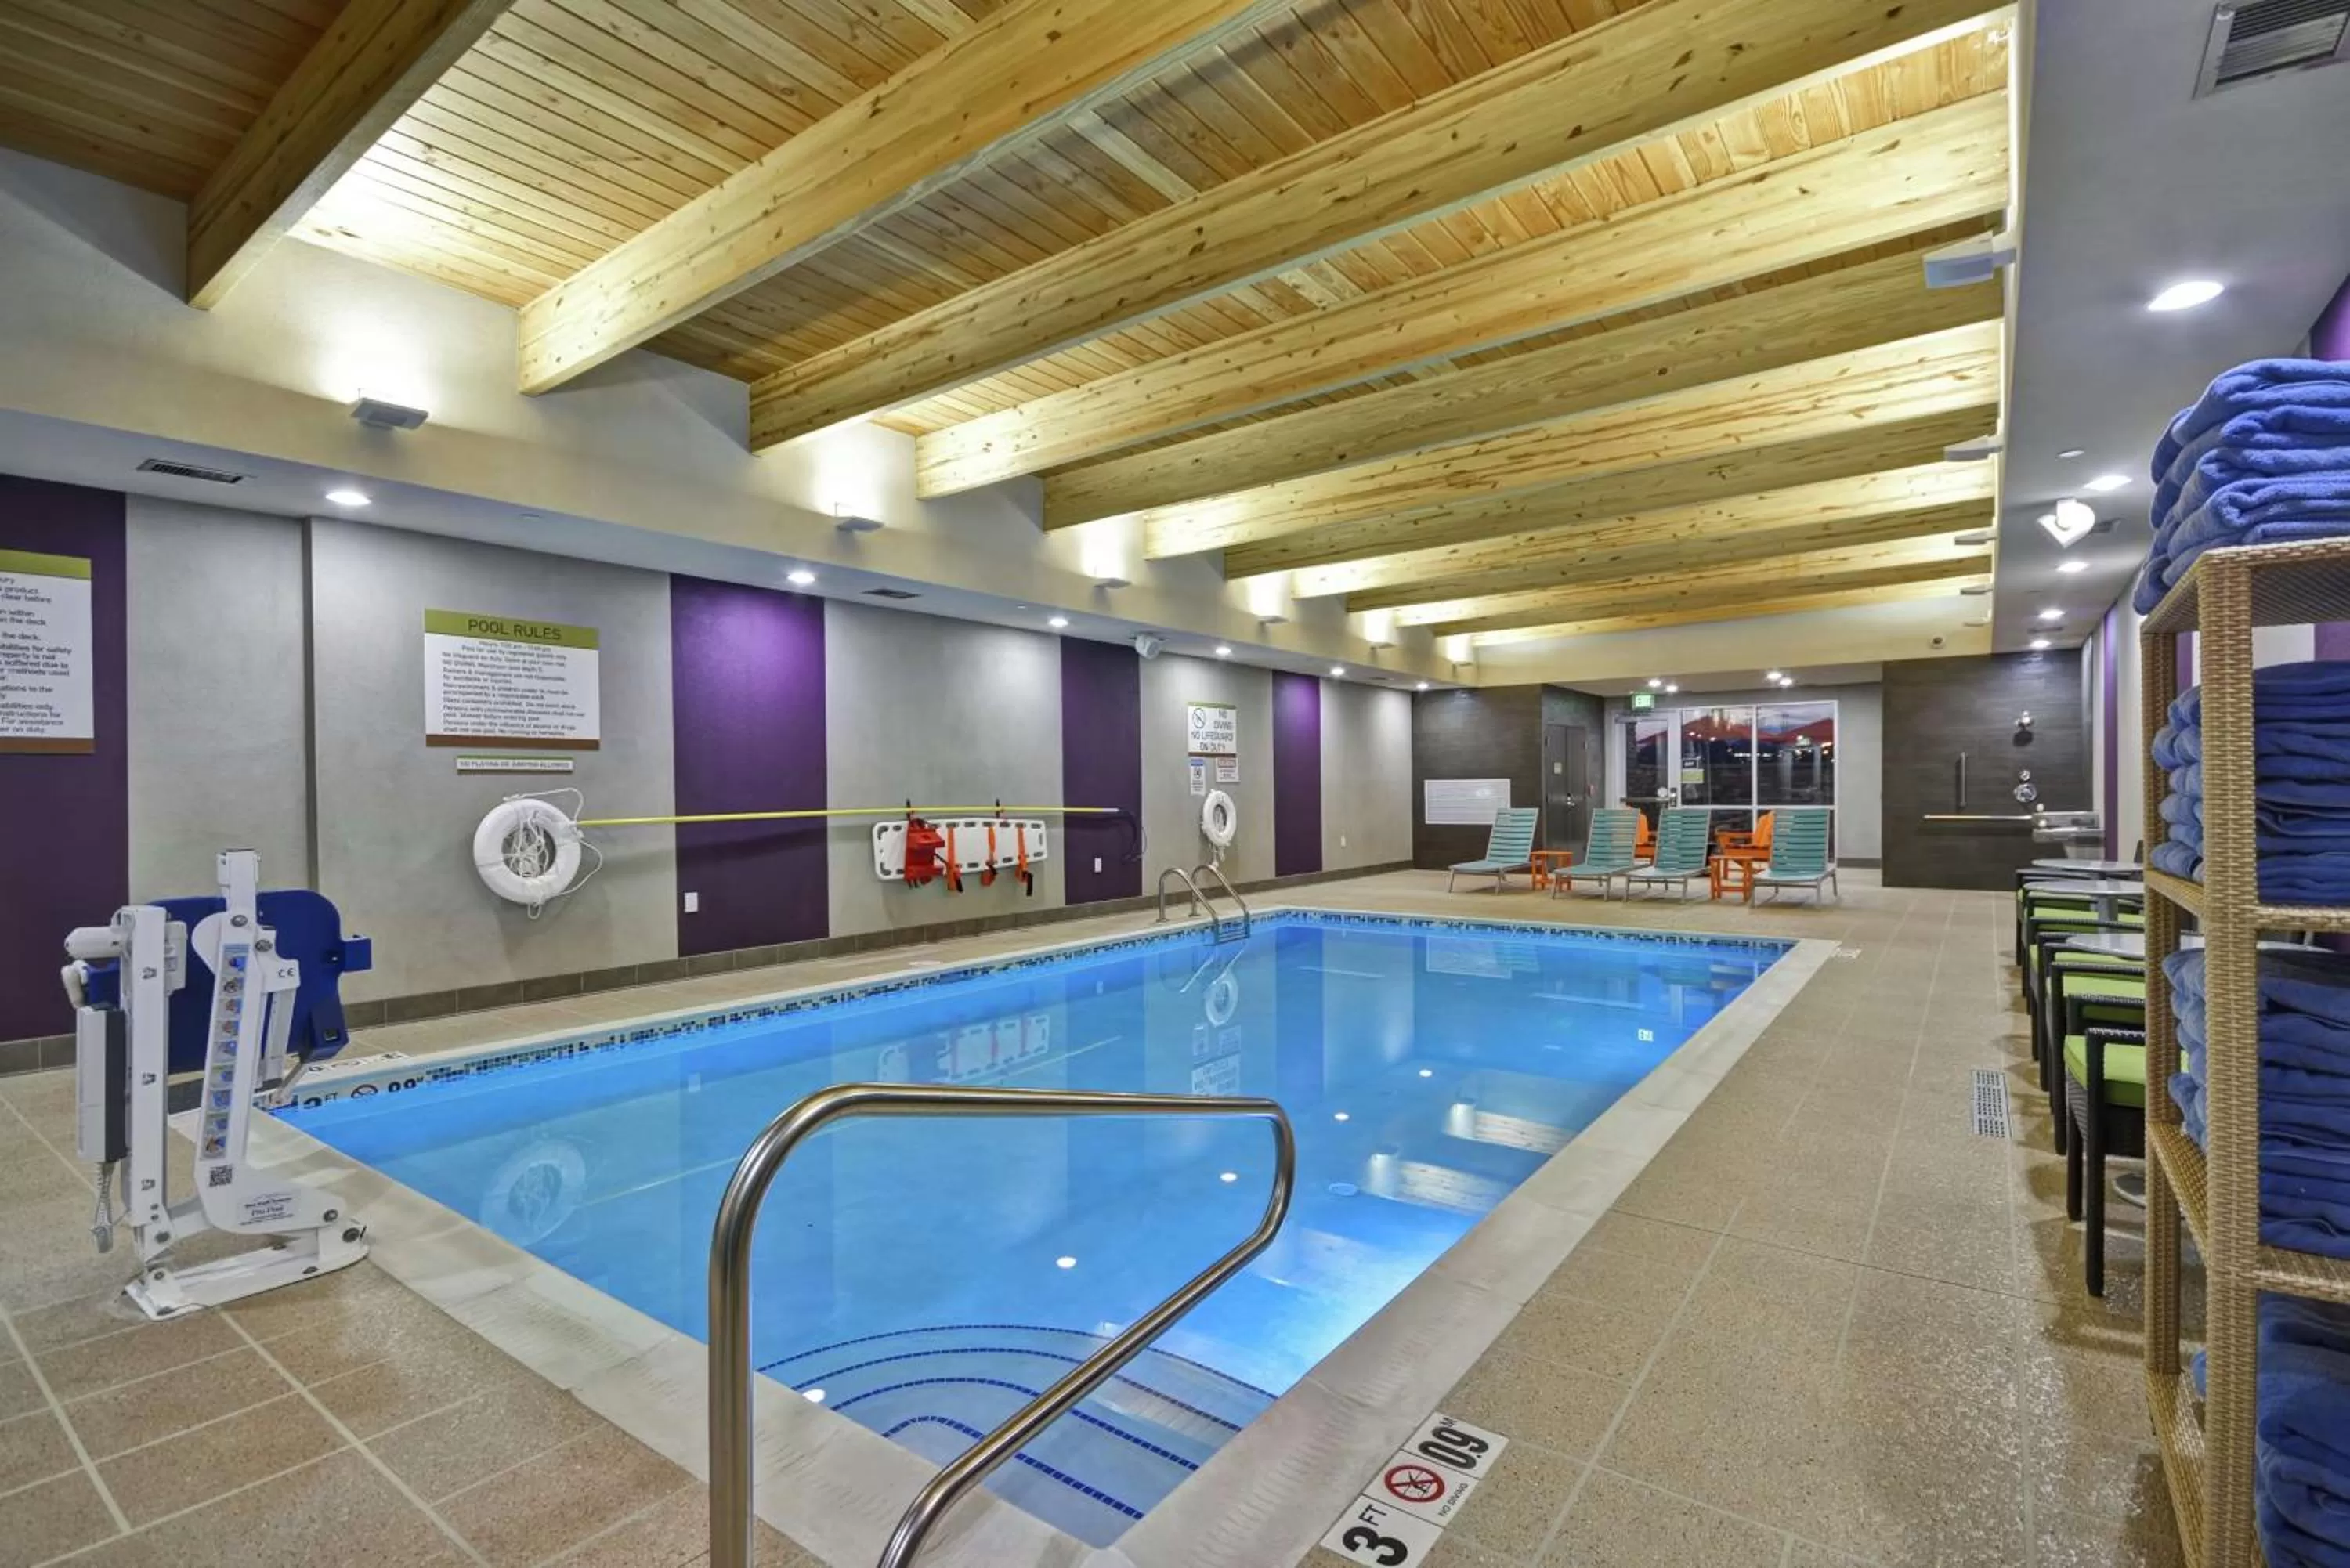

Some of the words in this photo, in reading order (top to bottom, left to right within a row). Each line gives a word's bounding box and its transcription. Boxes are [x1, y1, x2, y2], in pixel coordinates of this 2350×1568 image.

[468, 619, 510, 636] POOL
[514, 624, 562, 641] RULES
[1201, 731, 1234, 742] LIFEGUARD
[1437, 1504, 1452, 1517] NO
[1447, 1483, 1469, 1506] DIVING
[1358, 1504, 1387, 1527] FT
[1342, 1526, 1408, 1568] 3
